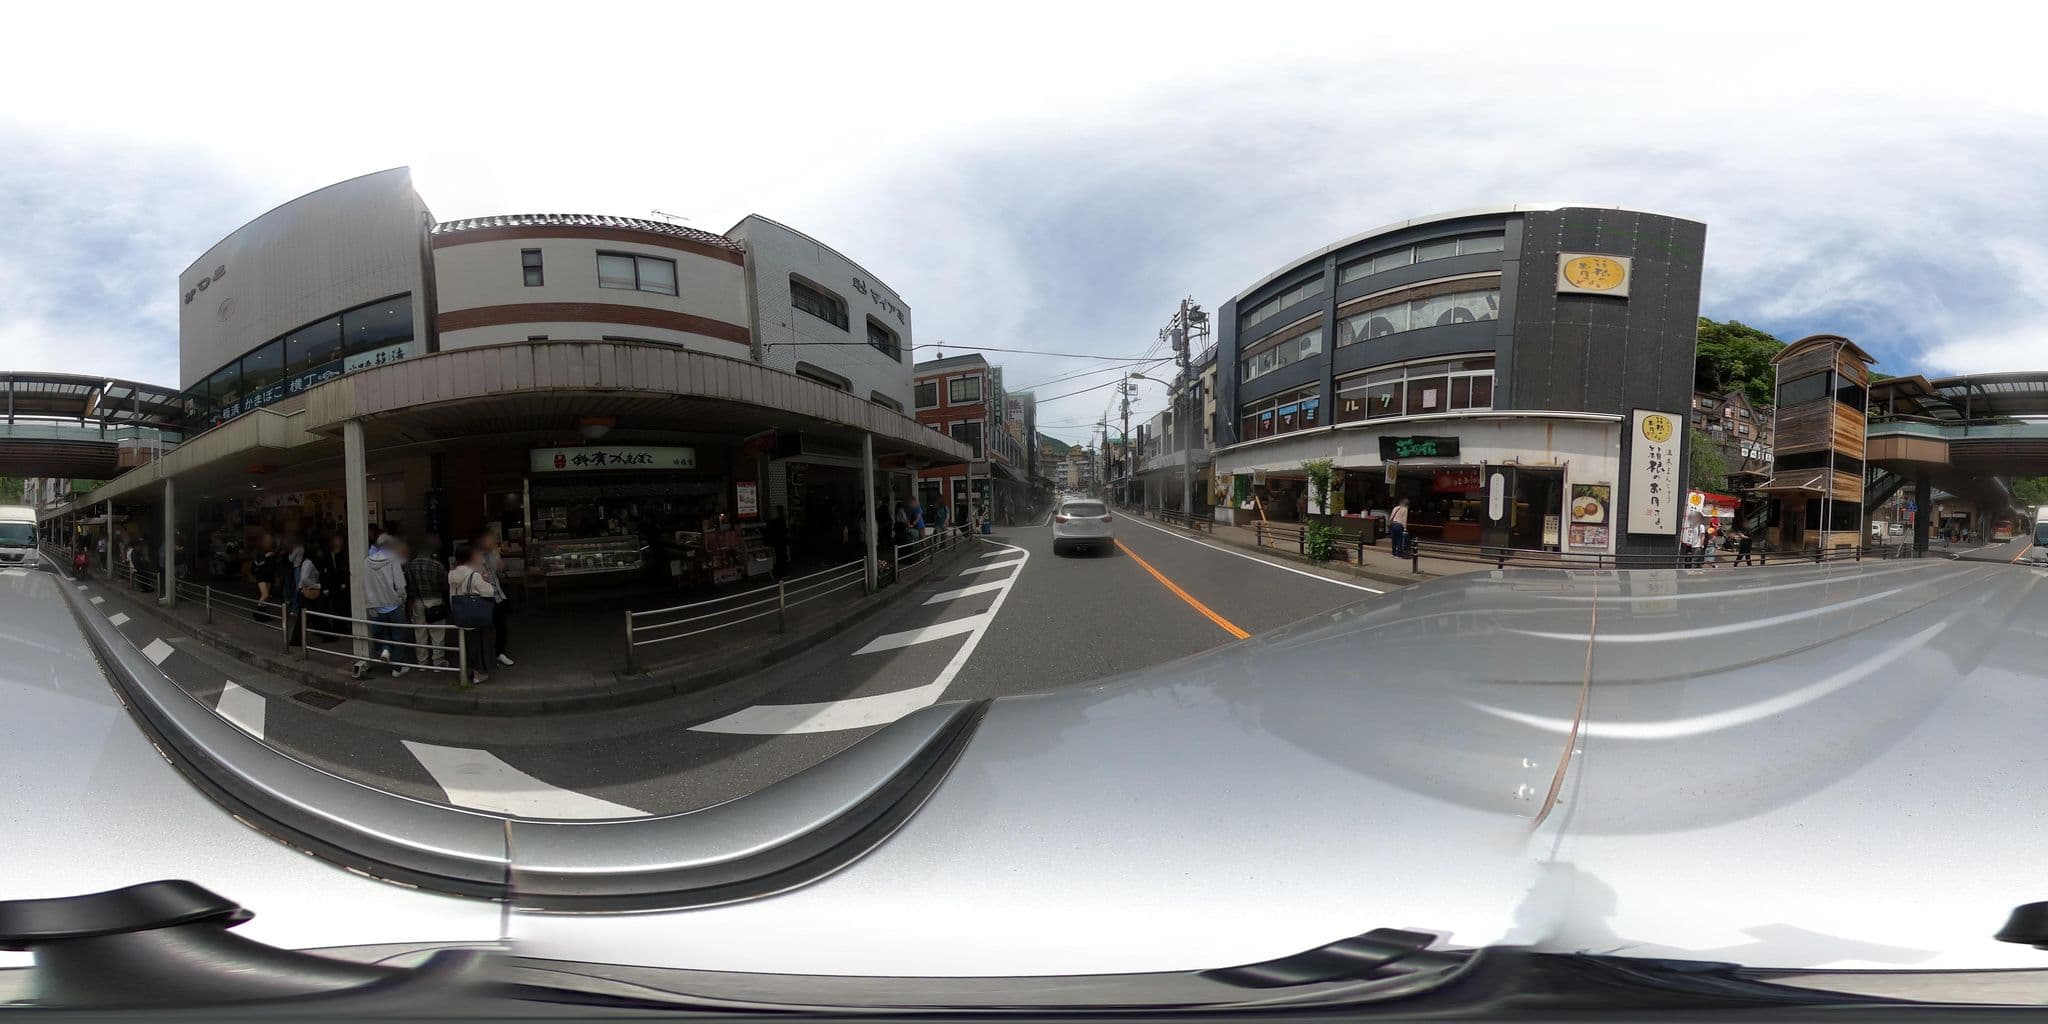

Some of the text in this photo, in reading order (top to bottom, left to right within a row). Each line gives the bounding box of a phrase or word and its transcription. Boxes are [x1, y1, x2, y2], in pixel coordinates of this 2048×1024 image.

[870, 288, 906, 326] マイアミ
[243, 385, 283, 410] かまぼこ
[289, 373, 318, 393] 横丁
